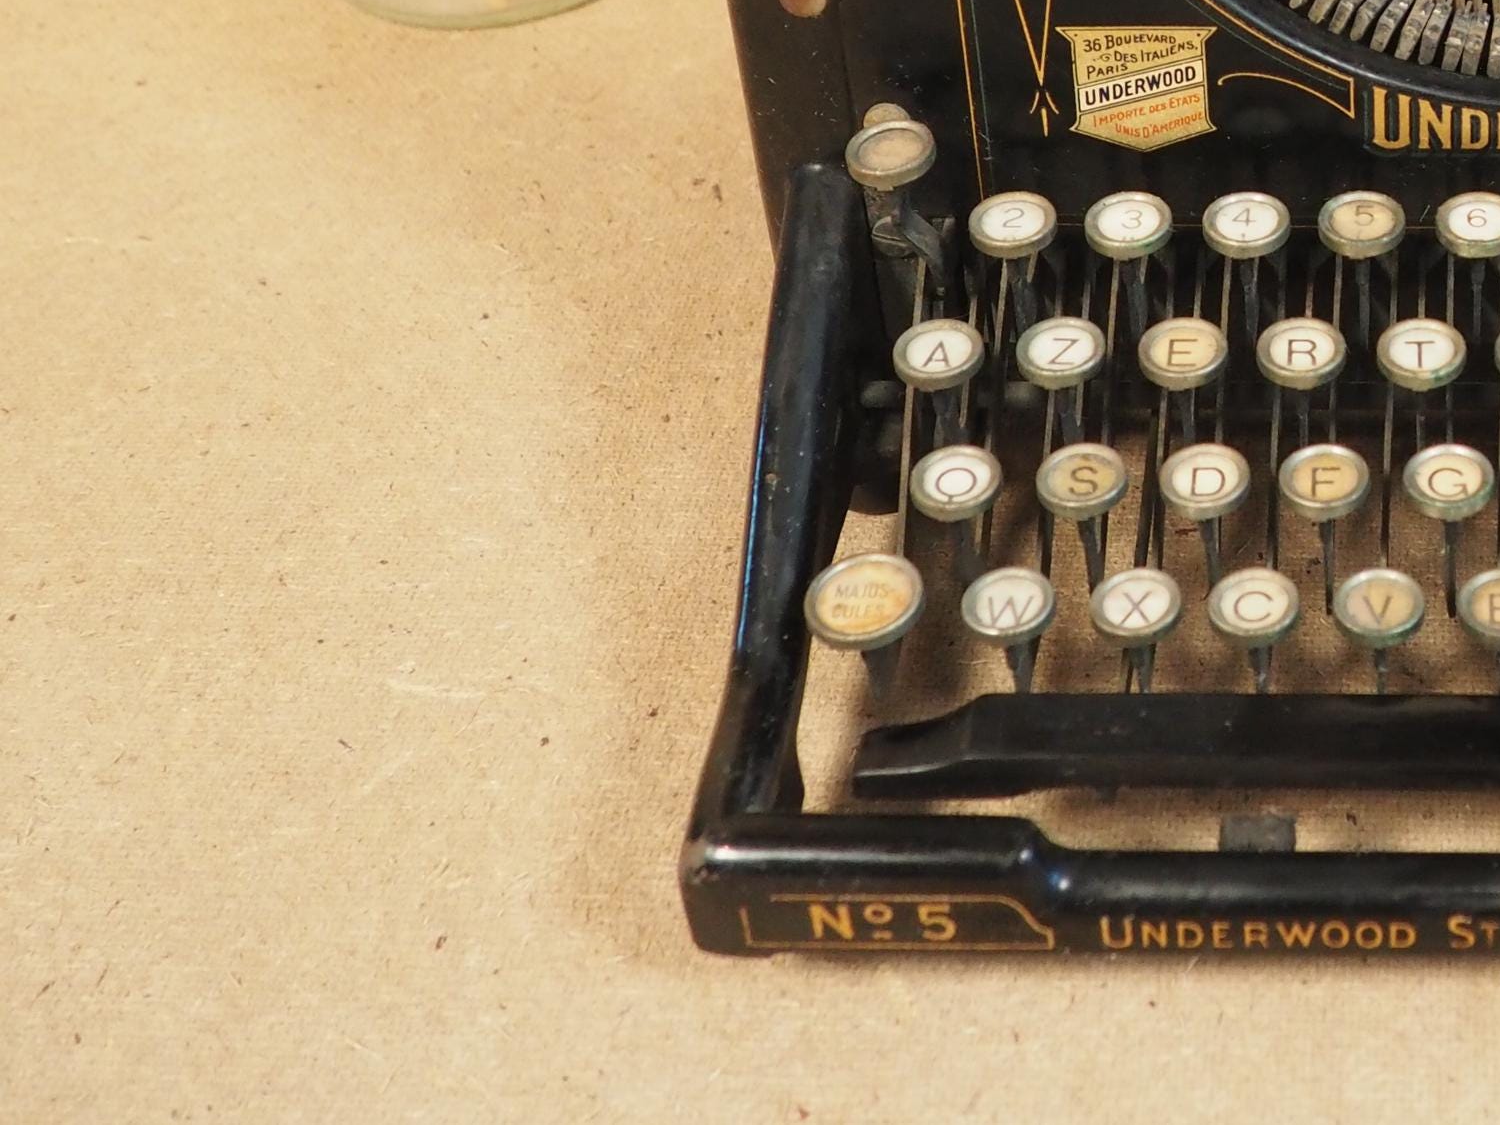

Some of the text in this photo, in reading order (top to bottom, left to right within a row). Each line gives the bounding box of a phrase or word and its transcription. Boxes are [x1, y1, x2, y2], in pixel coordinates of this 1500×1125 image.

[1082, 33, 1177, 53] 36 BOULEVARD
[1113, 50, 1138, 63] DES
[1085, 65, 1197, 106] UNDERWOOD
[1086, 63, 1128, 80] PARIS
[1093, 106, 1146, 128] IMPORTE
[1114, 122, 1141, 138] UNIS
[1002, 207, 1025, 229] 2
[1121, 209, 1143, 230] 3
[1232, 207, 1257, 227] 4
[1354, 204, 1375, 227] 5
[1466, 208, 1488, 228] 6
[922, 340, 950, 368] A
[1047, 337, 1080, 366] Z
[1166, 338, 1199, 367] E
[1286, 338, 1317, 367] R
[1404, 340, 1436, 369] T
[1068, 465, 1099, 497] S
[1190, 466, 1226, 497] D
[1310, 465, 1342, 498] F
[1428, 467, 1470, 498] G
[987, 594, 1034, 626] W
[1119, 590, 1154, 625] X
[1233, 589, 1273, 623] C
[1362, 594, 1393, 625] V
[919, 902, 959, 942] 5
[1099, 915, 1418, 951] UNDERWOOD
